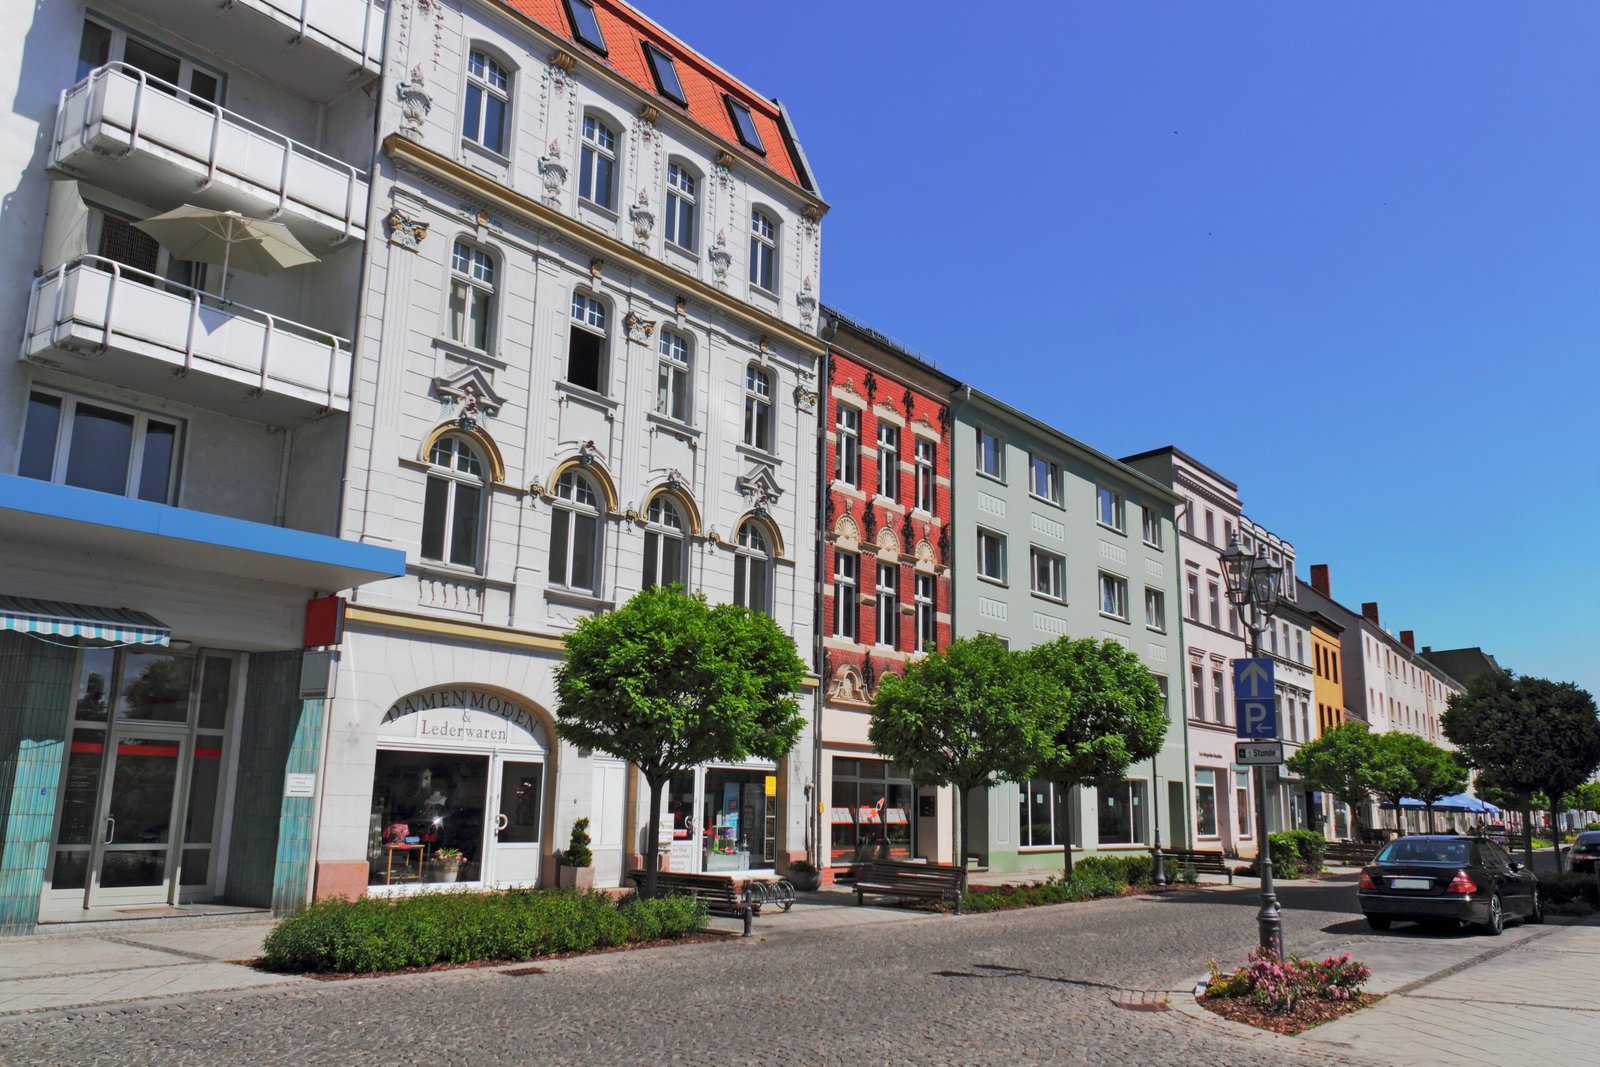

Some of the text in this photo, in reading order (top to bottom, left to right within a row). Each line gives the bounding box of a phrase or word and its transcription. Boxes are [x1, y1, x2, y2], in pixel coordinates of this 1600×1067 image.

[387, 690, 539, 733] DAMENMODEN
[462, 710, 472, 723] &
[1245, 703, 1267, 734] P
[421, 719, 507, 740] Lederwaren
[1253, 749, 1276, 758] Stunde
